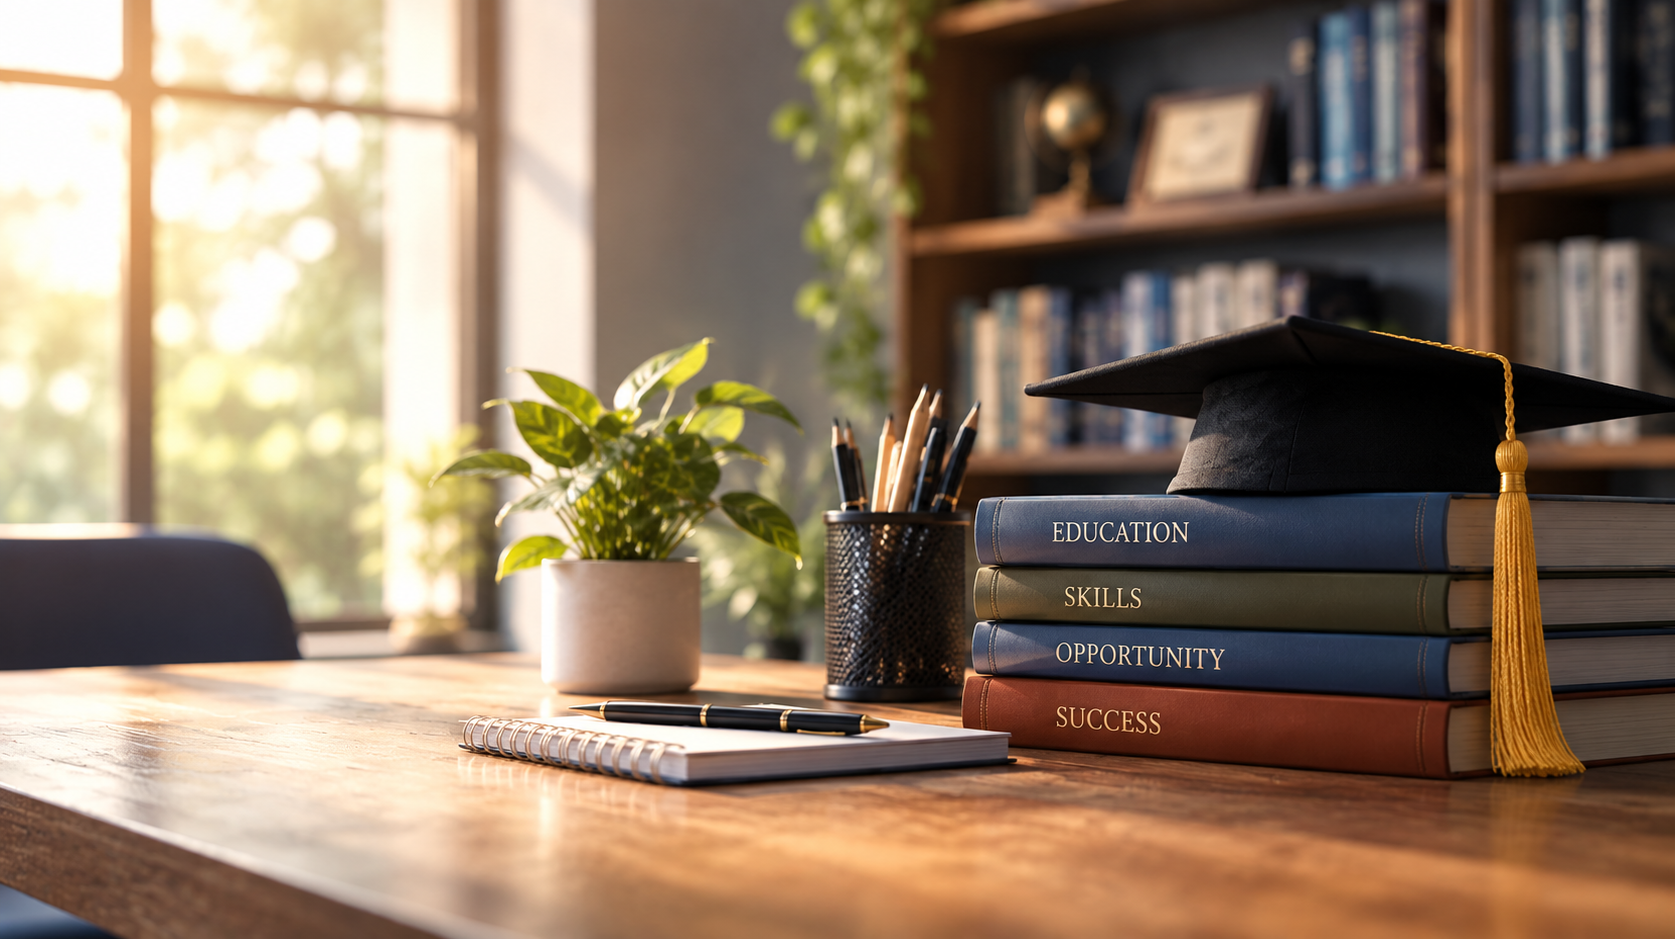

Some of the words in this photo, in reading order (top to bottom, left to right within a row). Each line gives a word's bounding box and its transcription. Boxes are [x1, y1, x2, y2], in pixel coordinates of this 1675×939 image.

[1052, 521, 1190, 544] EDUCATION
[1064, 586, 1143, 609] SKILLS
[1055, 641, 1225, 671] OPPORTUNITY
[1056, 705, 1162, 735] SUCCESS
